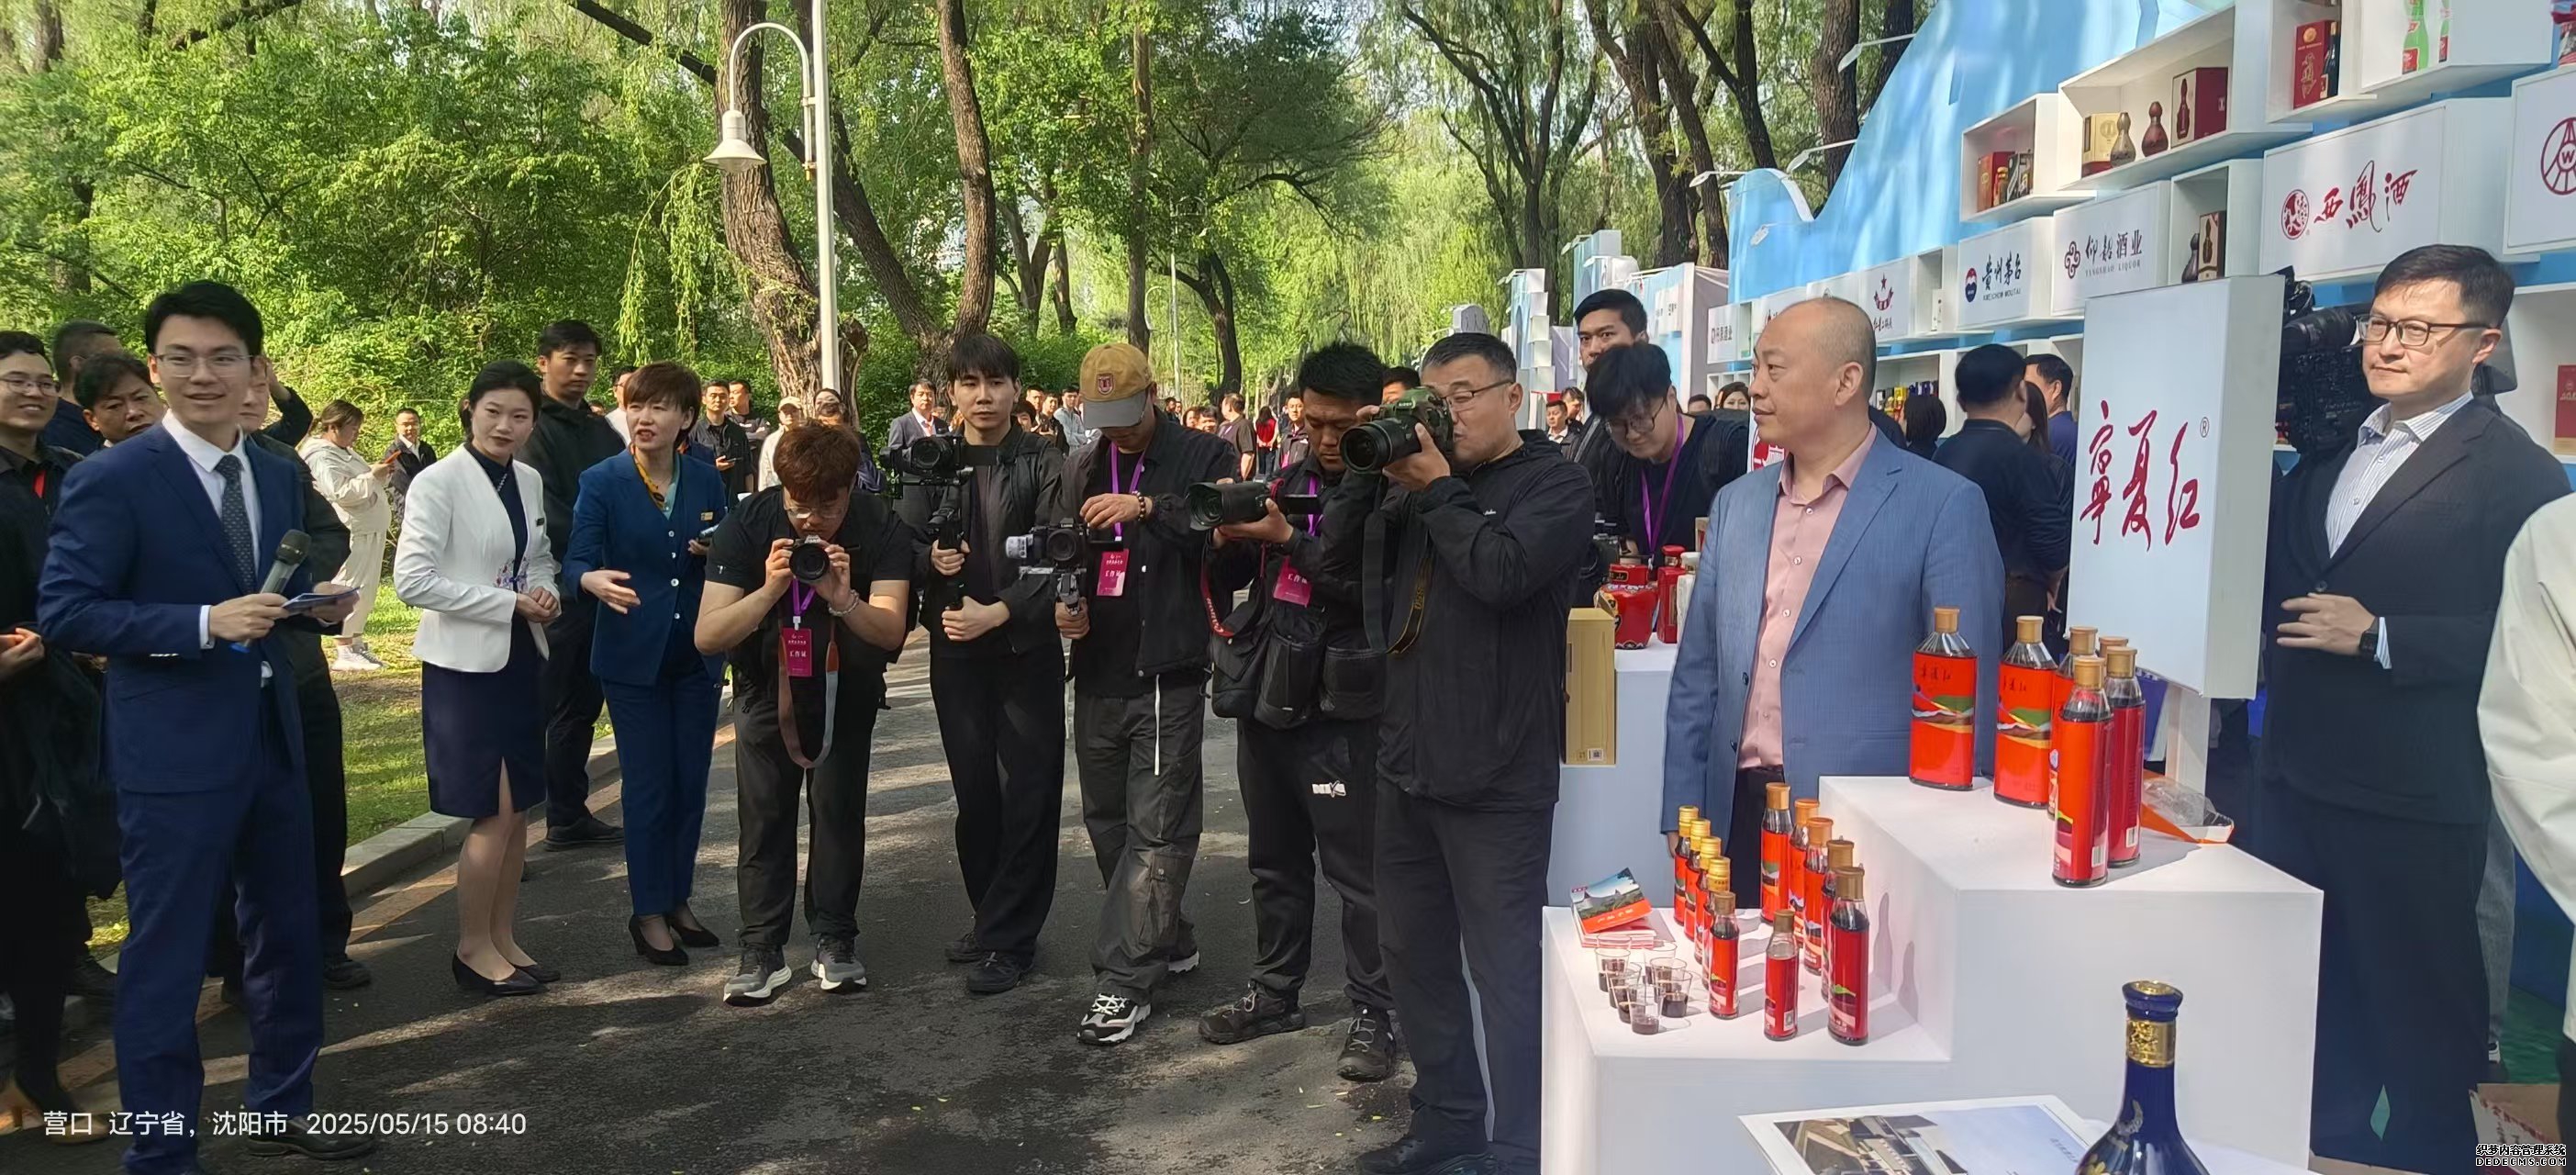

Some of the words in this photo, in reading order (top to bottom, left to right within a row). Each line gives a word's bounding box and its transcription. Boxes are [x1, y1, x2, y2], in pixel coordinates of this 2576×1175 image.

[2118, 259, 2141, 272] LIQUOR
[1983, 291, 2004, 301] KWEICHOW
[2004, 287, 2022, 297] MOUTAI
